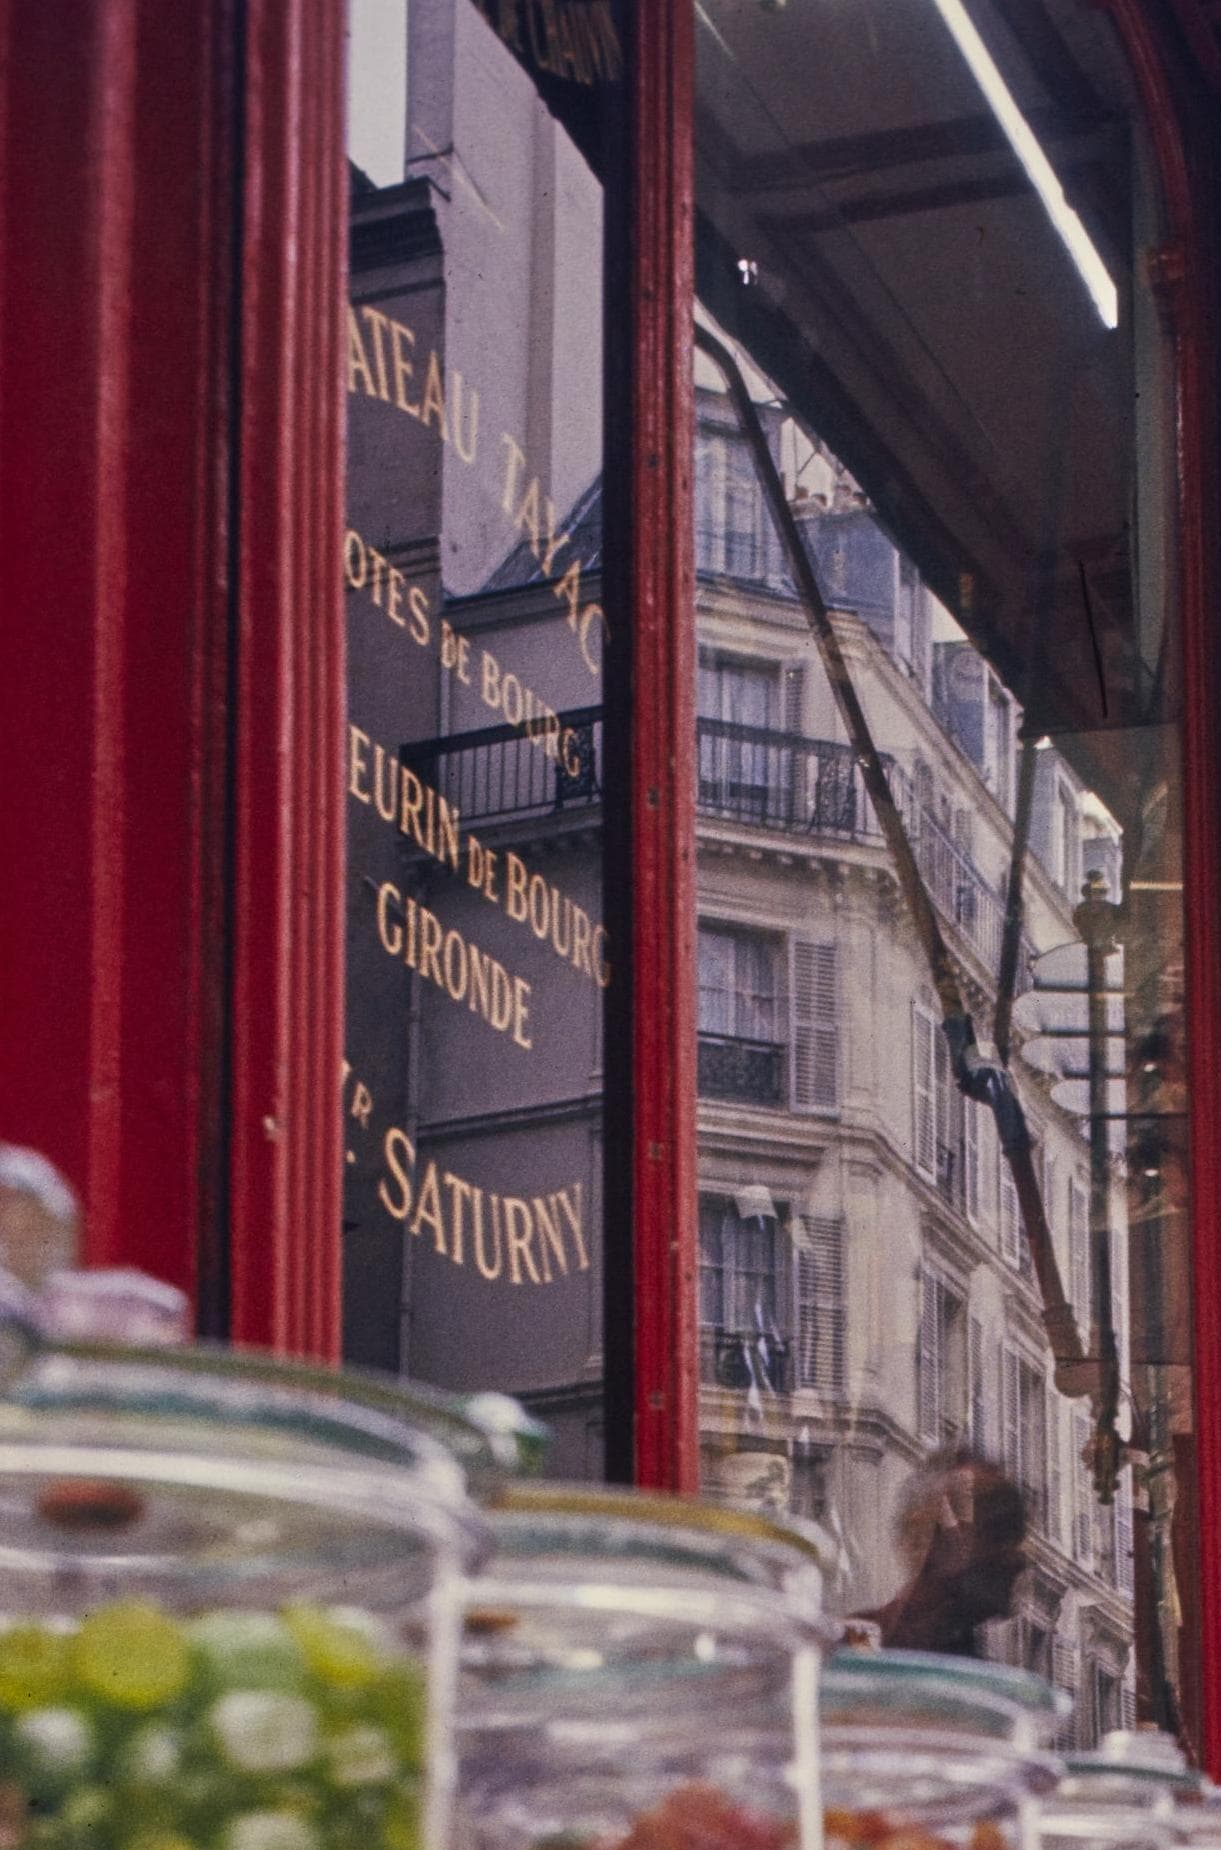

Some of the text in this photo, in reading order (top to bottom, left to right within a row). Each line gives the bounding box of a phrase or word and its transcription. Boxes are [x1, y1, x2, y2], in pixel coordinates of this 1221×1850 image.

[440, 618, 472, 687] DE
[481, 650, 581, 778] BOURG
[348, 723, 612, 988] EURIN DE BOURG
[376, 883, 534, 1050] GIRONDE
[377, 1126, 591, 1286] SATURNY
